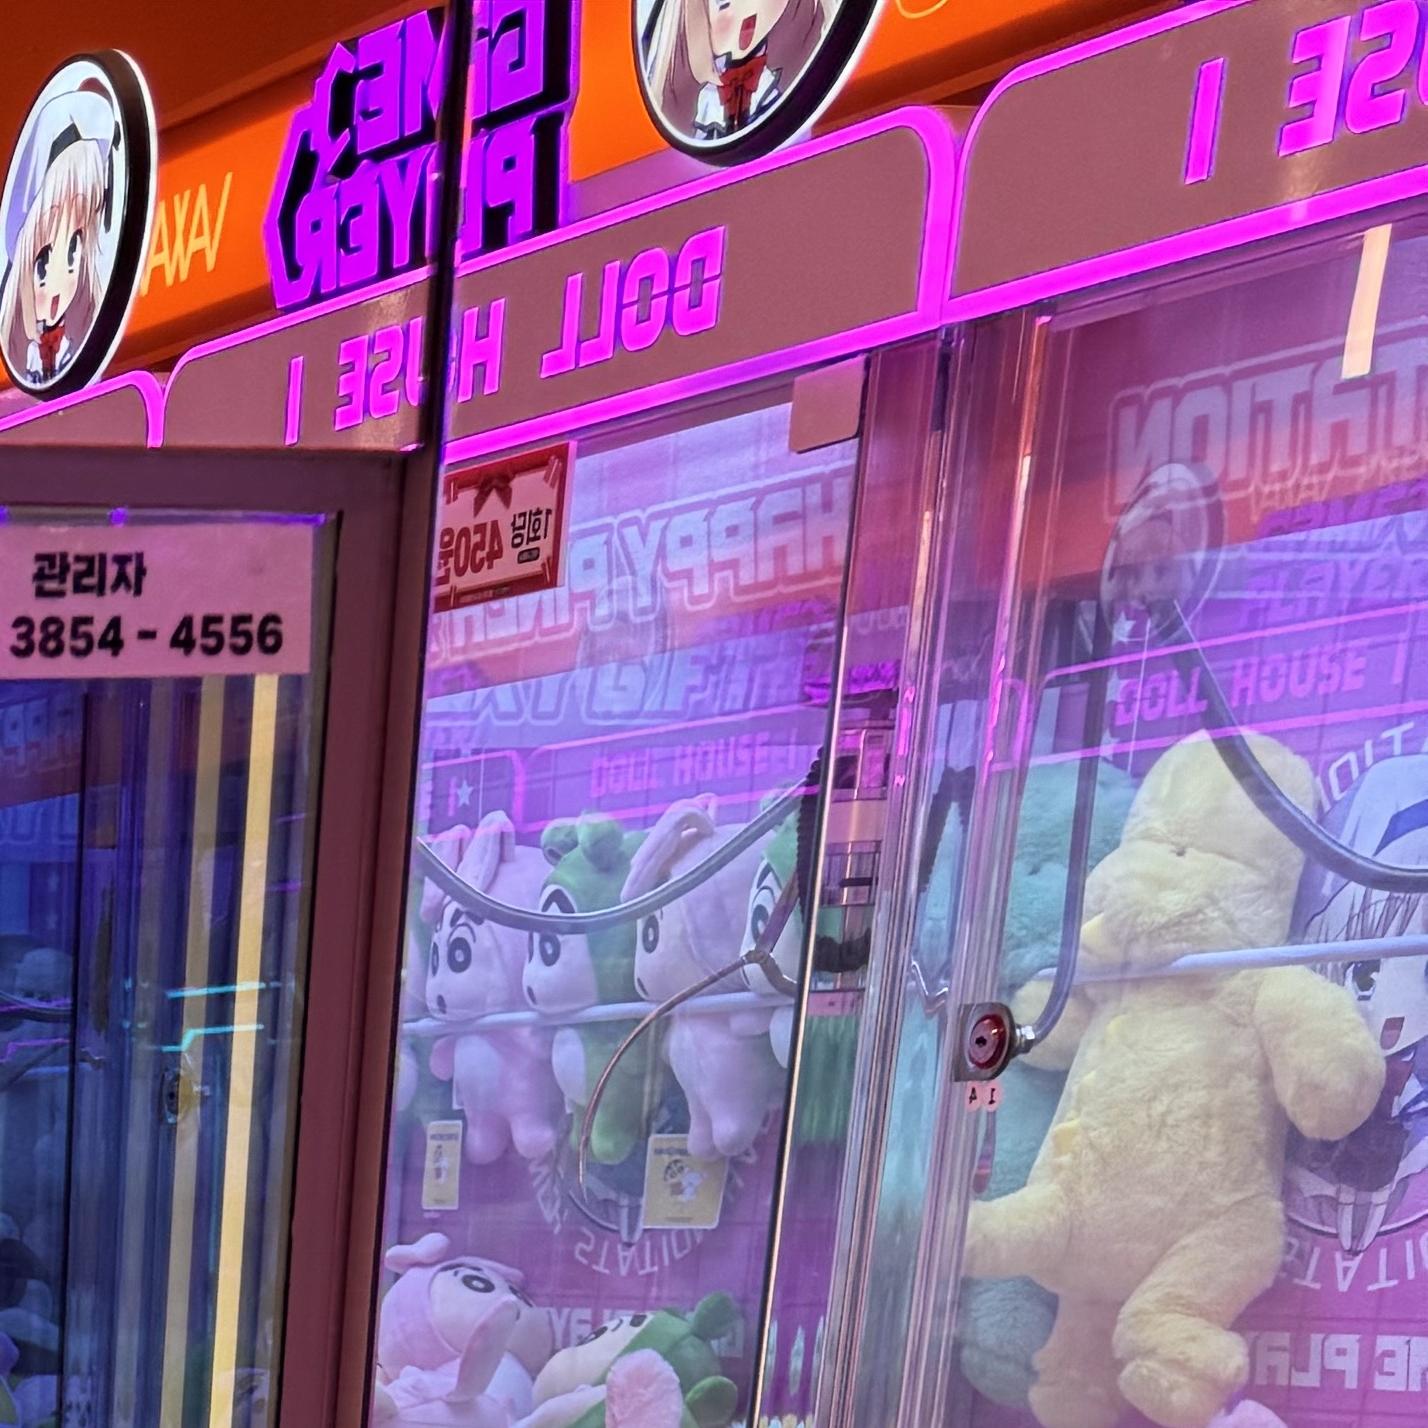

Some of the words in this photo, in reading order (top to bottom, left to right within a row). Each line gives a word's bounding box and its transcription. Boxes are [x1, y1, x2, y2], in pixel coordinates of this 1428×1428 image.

[32, 552, 147, 599] 관리자
[10, 614, 125, 658] 3854
[168, 612, 284, 657] 4556
